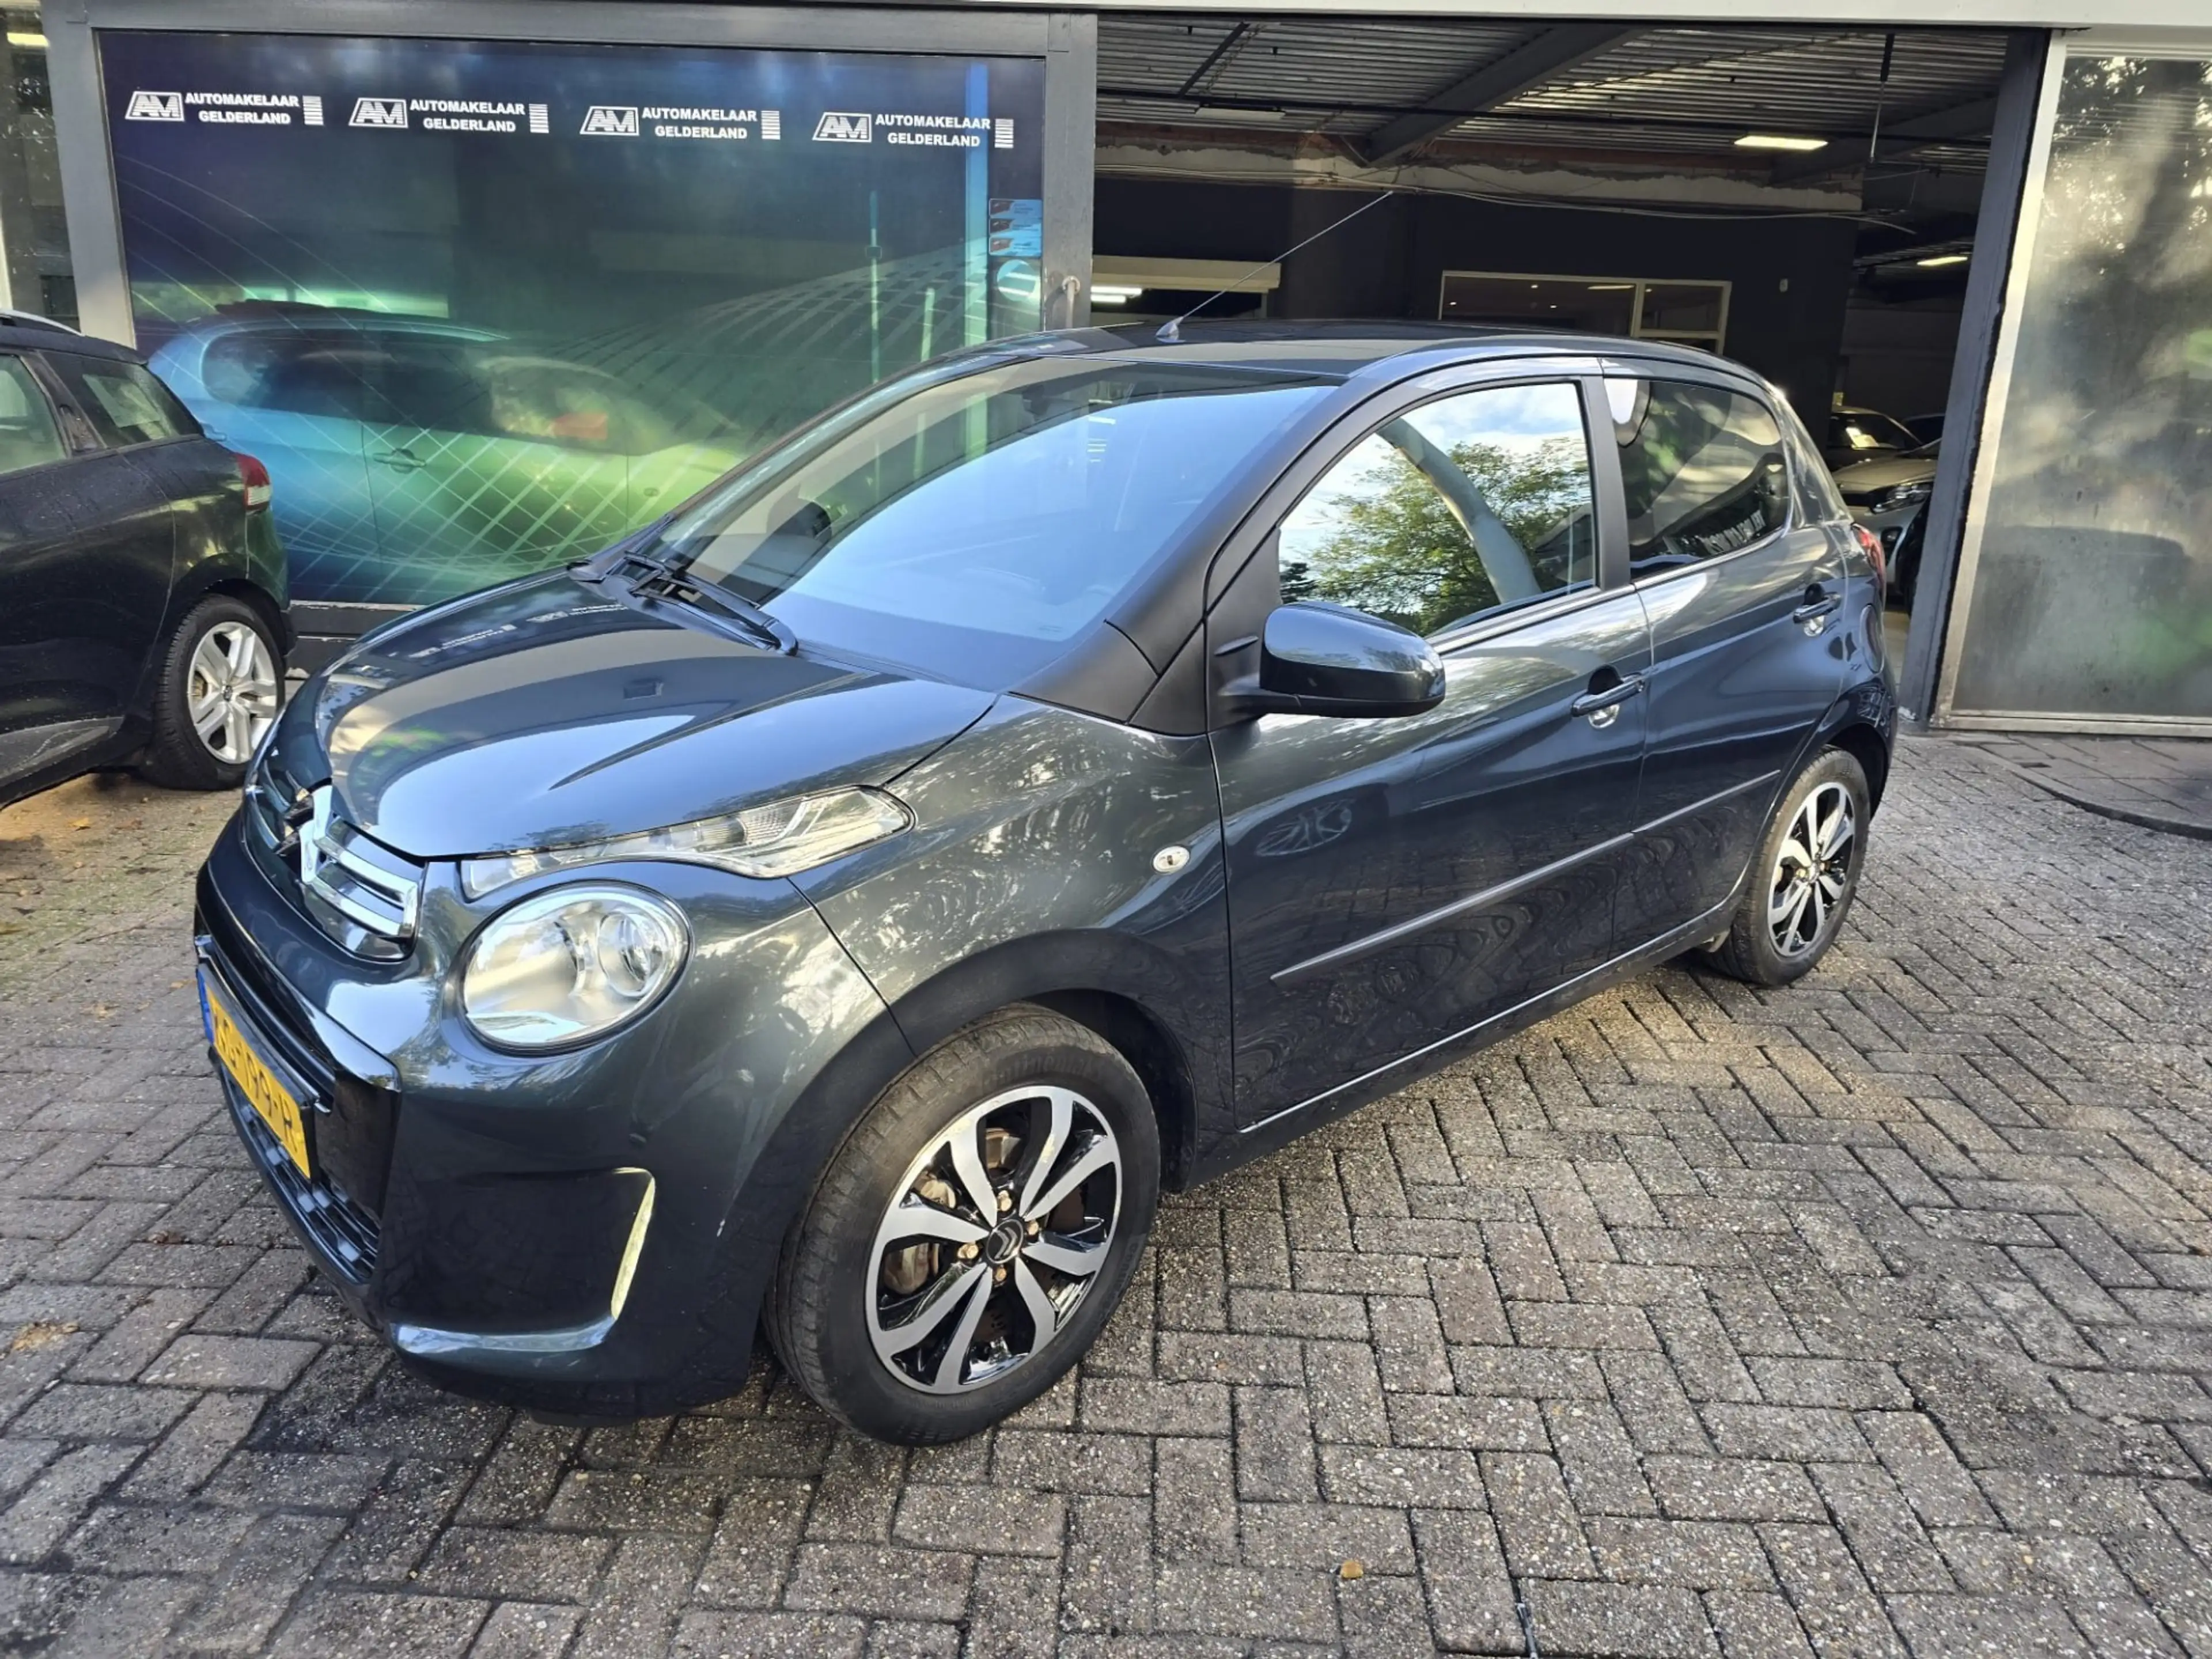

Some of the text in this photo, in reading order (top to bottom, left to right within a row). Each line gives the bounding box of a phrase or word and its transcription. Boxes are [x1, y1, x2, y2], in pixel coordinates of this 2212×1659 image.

[132, 94, 179, 117] AM
[185, 92, 300, 107] AUTOMAKELAAR
[410, 99, 526, 115] AUTOMAKELAAR
[198, 110, 291, 124] GELDERLAND
[356, 101, 403, 124] AM
[642, 107, 758, 122] AUTOMAKELAAR
[423, 117, 516, 132] GELDERLAND
[587, 109, 635, 132] AM
[819, 116, 867, 139] AM
[875, 113, 990, 130] AUTOMAKELAAR
[654, 125, 748, 139] GELDERLAND
[888, 132, 980, 147] GELDERLAND
